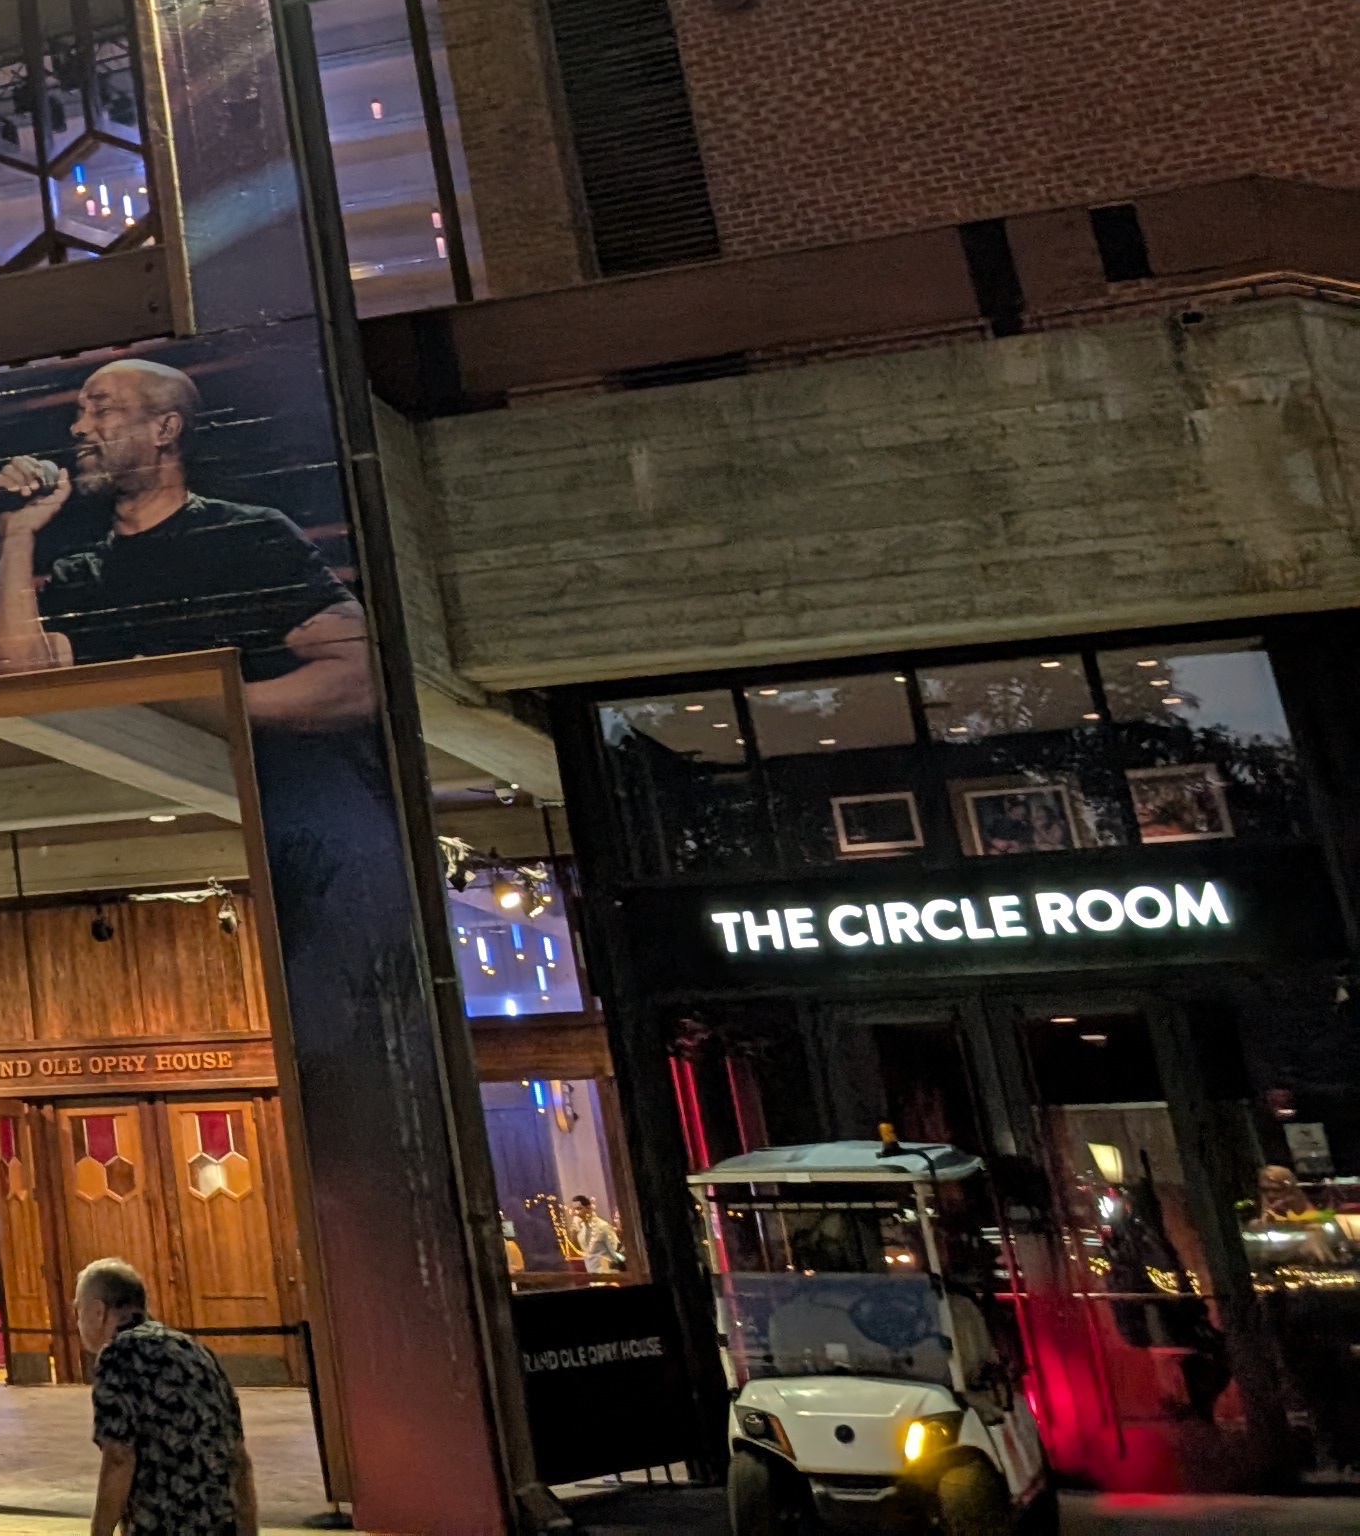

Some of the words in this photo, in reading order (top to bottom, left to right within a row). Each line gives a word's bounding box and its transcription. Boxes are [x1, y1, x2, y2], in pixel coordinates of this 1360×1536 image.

[711, 907, 820, 953] THE
[827, 895, 1028, 947] CIRCLE
[1035, 881, 1231, 936] ROOM
[38, 1057, 83, 1076] OLE
[88, 1054, 147, 1074] OPRY
[154, 1051, 233, 1072] HOUSE
[559, 1345, 588, 1368] OLE
